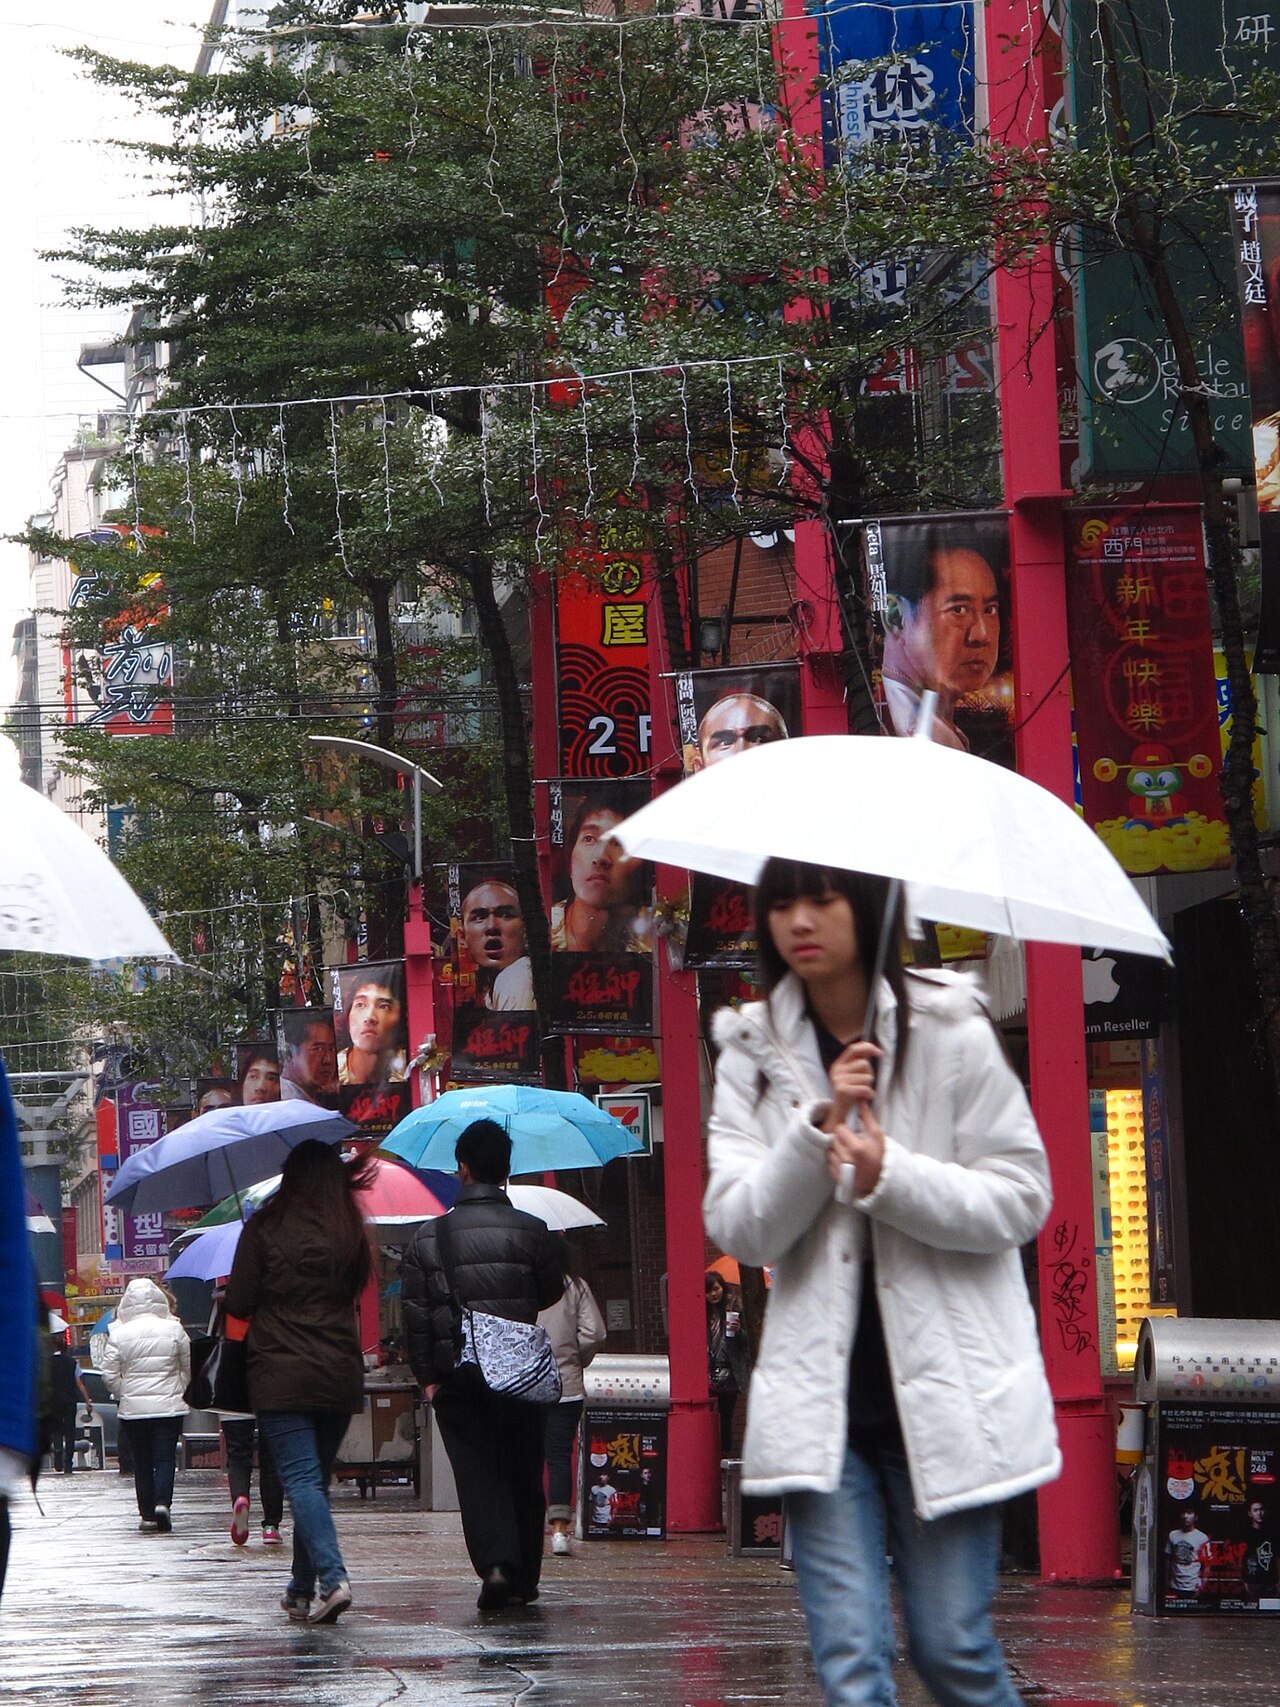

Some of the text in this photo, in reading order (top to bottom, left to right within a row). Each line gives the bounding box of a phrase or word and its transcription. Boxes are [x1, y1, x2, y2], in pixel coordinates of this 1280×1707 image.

[1234, 14, 1275, 53] 研
[1160, 409, 1243, 432] Sice
[866, 522, 880, 556] Geta
[1103, 537, 1143, 557] 西門
[1116, 574, 1165, 732] 新年快樂
[1104, 1018, 1150, 1032] Reseller
[1172, 1355, 1279, 1367] 行人專用清潔箱
[1251, 1464, 1267, 1473] 249
